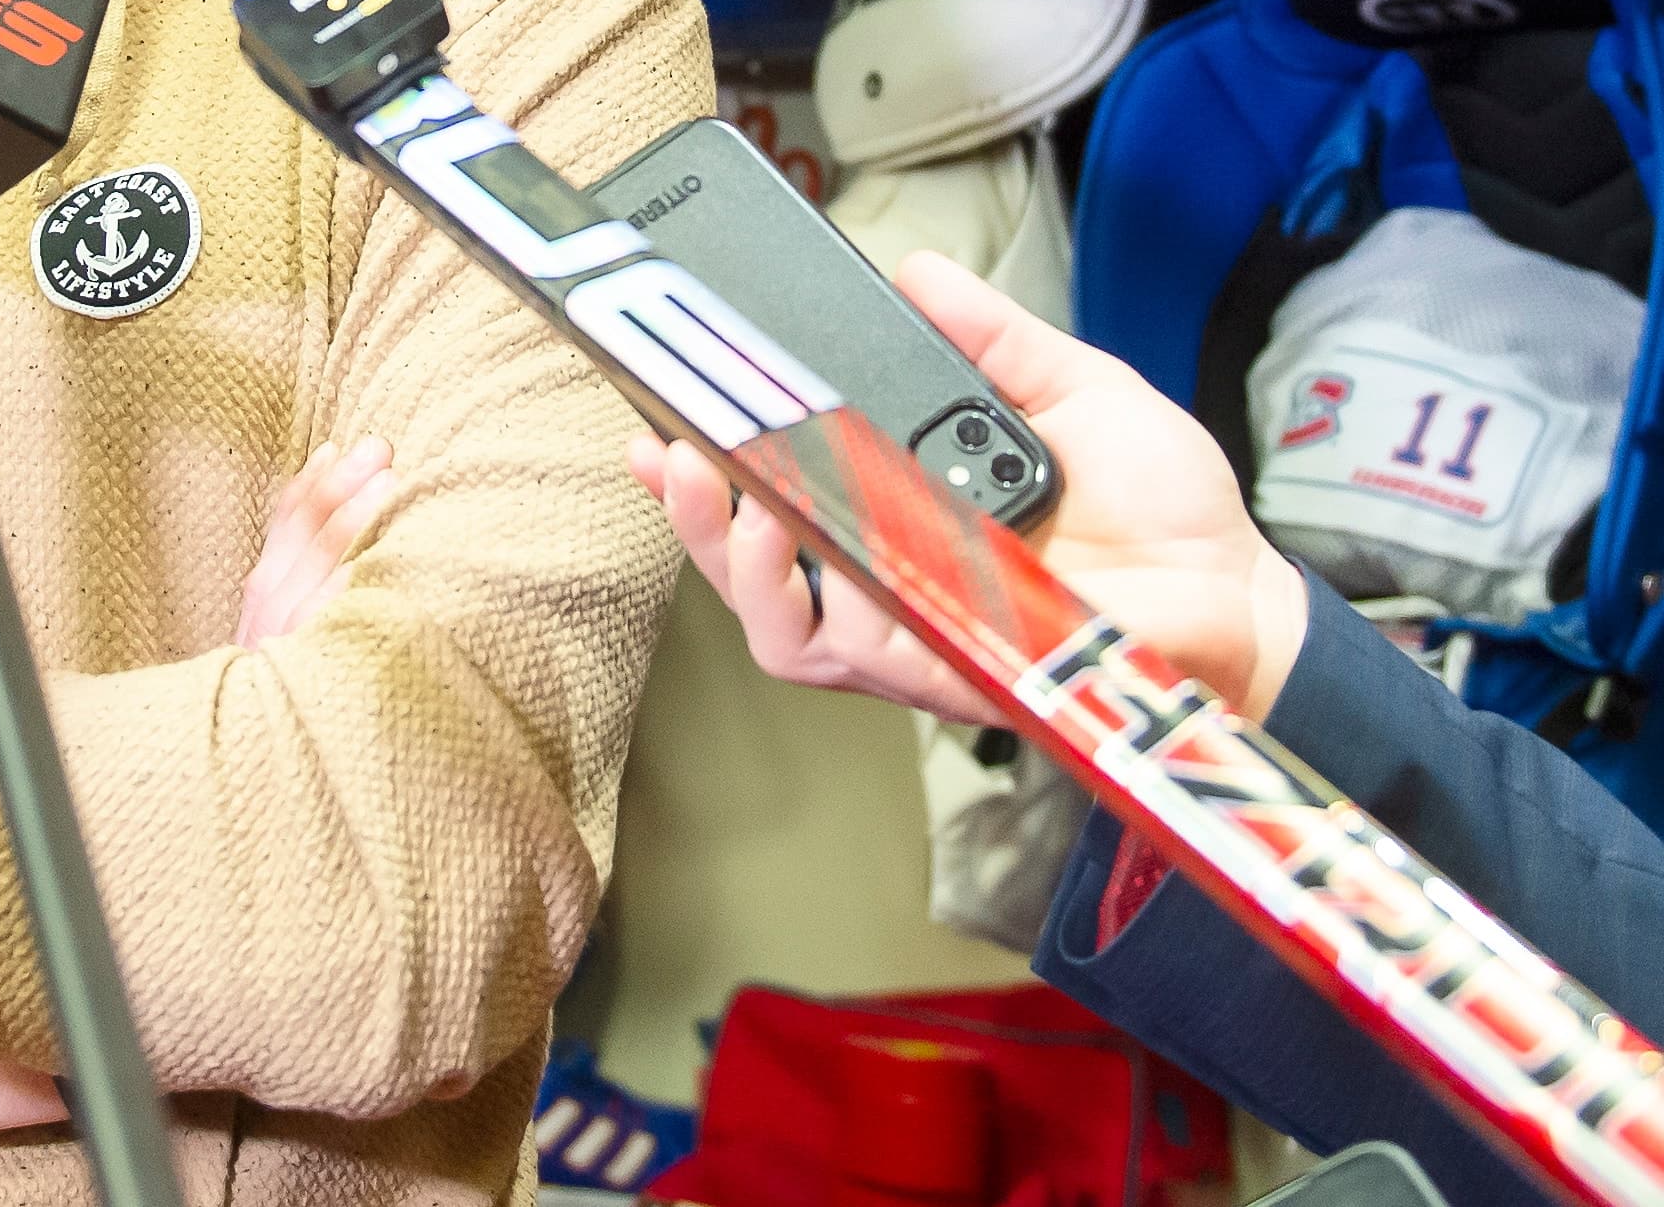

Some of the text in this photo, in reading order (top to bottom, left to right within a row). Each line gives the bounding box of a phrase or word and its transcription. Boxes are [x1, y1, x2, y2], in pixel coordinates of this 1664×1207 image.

[47, 174, 182, 234] EAST COAST
[51, 247, 176, 300] LIFESTYLE
[1392, 393, 1491, 481] 11
